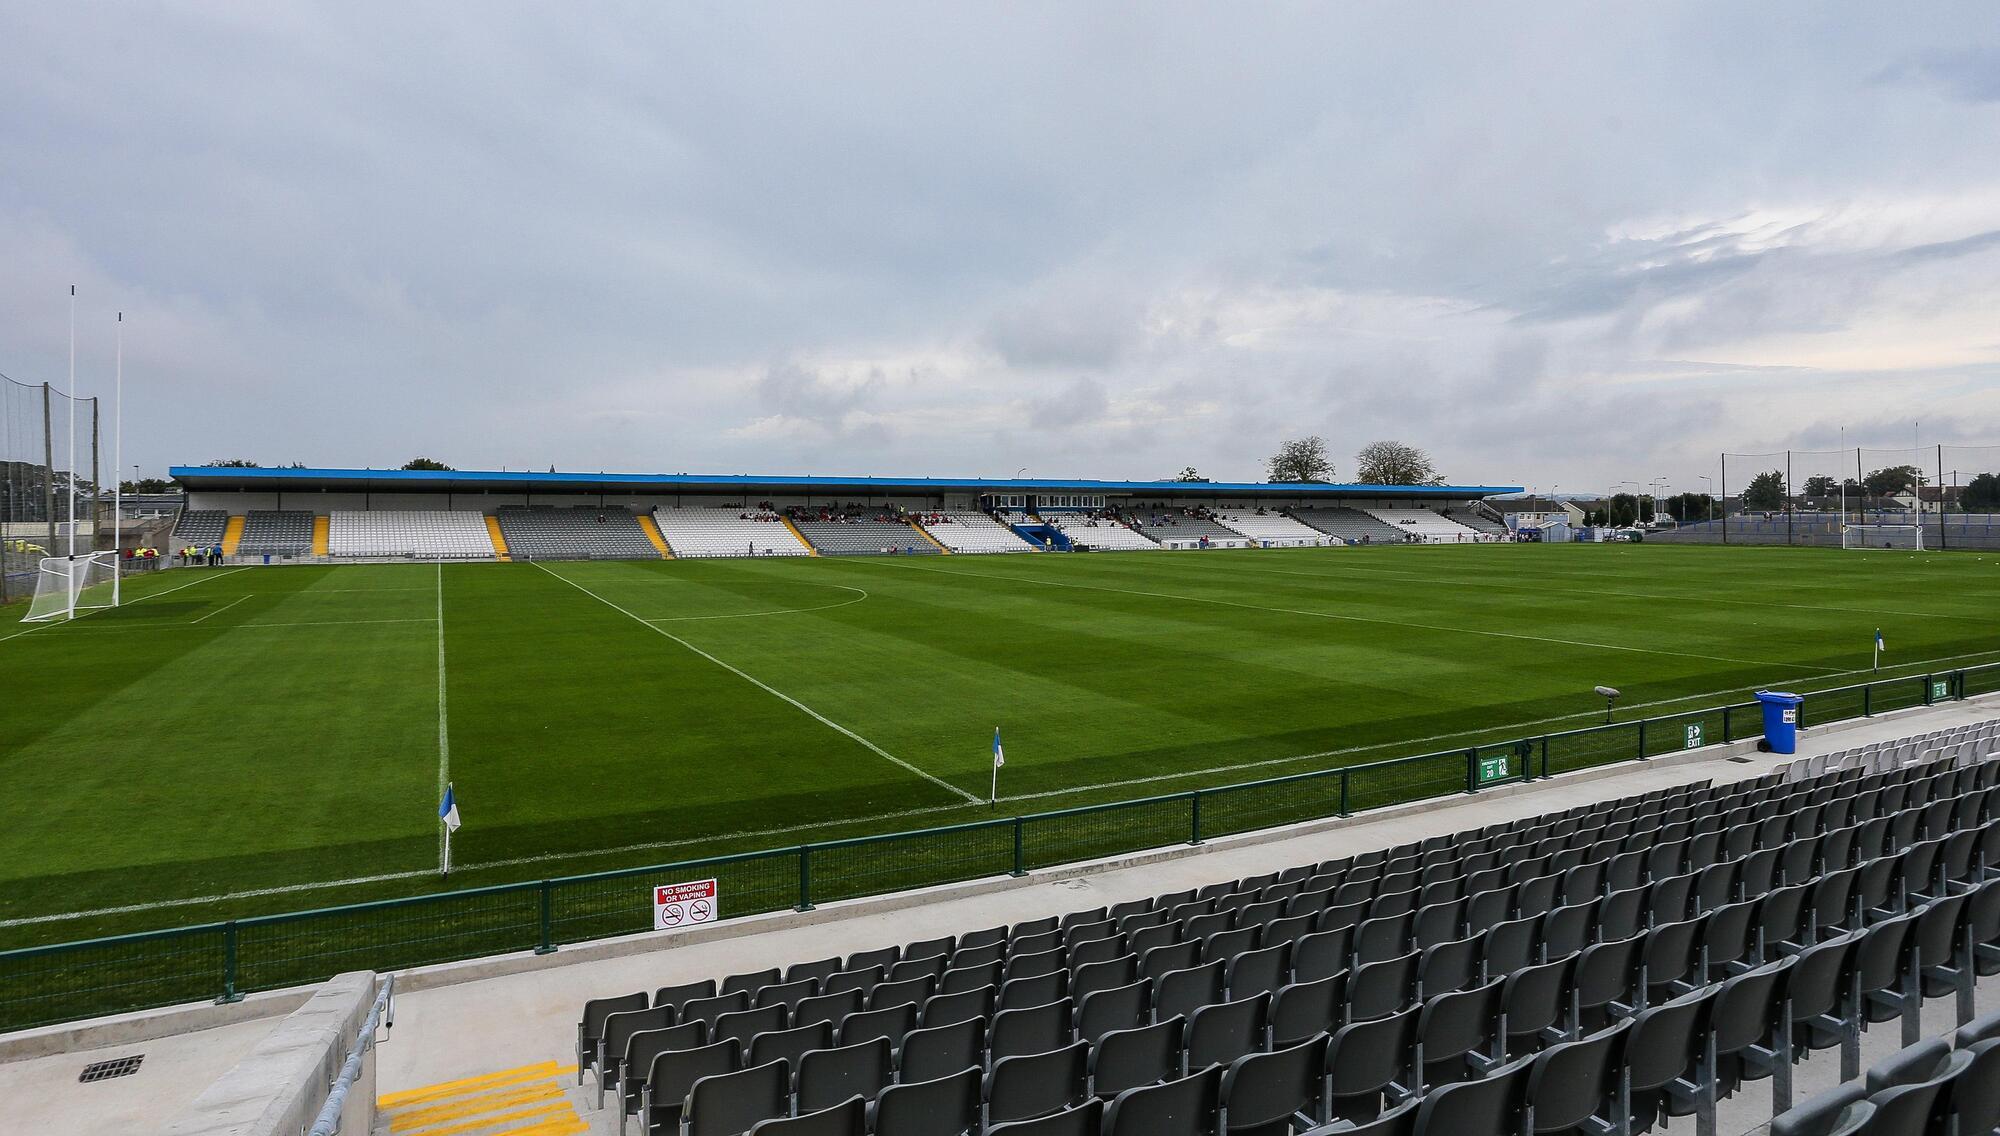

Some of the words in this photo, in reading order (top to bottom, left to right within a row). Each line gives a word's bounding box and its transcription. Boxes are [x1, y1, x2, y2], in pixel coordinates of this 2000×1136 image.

[1687, 737, 1701, 747] EXIT
[662, 888, 674, 896] NO
[675, 882, 710, 894] SMOKING
[666, 895, 678, 903] OR
[679, 890, 707, 901] VAPING
